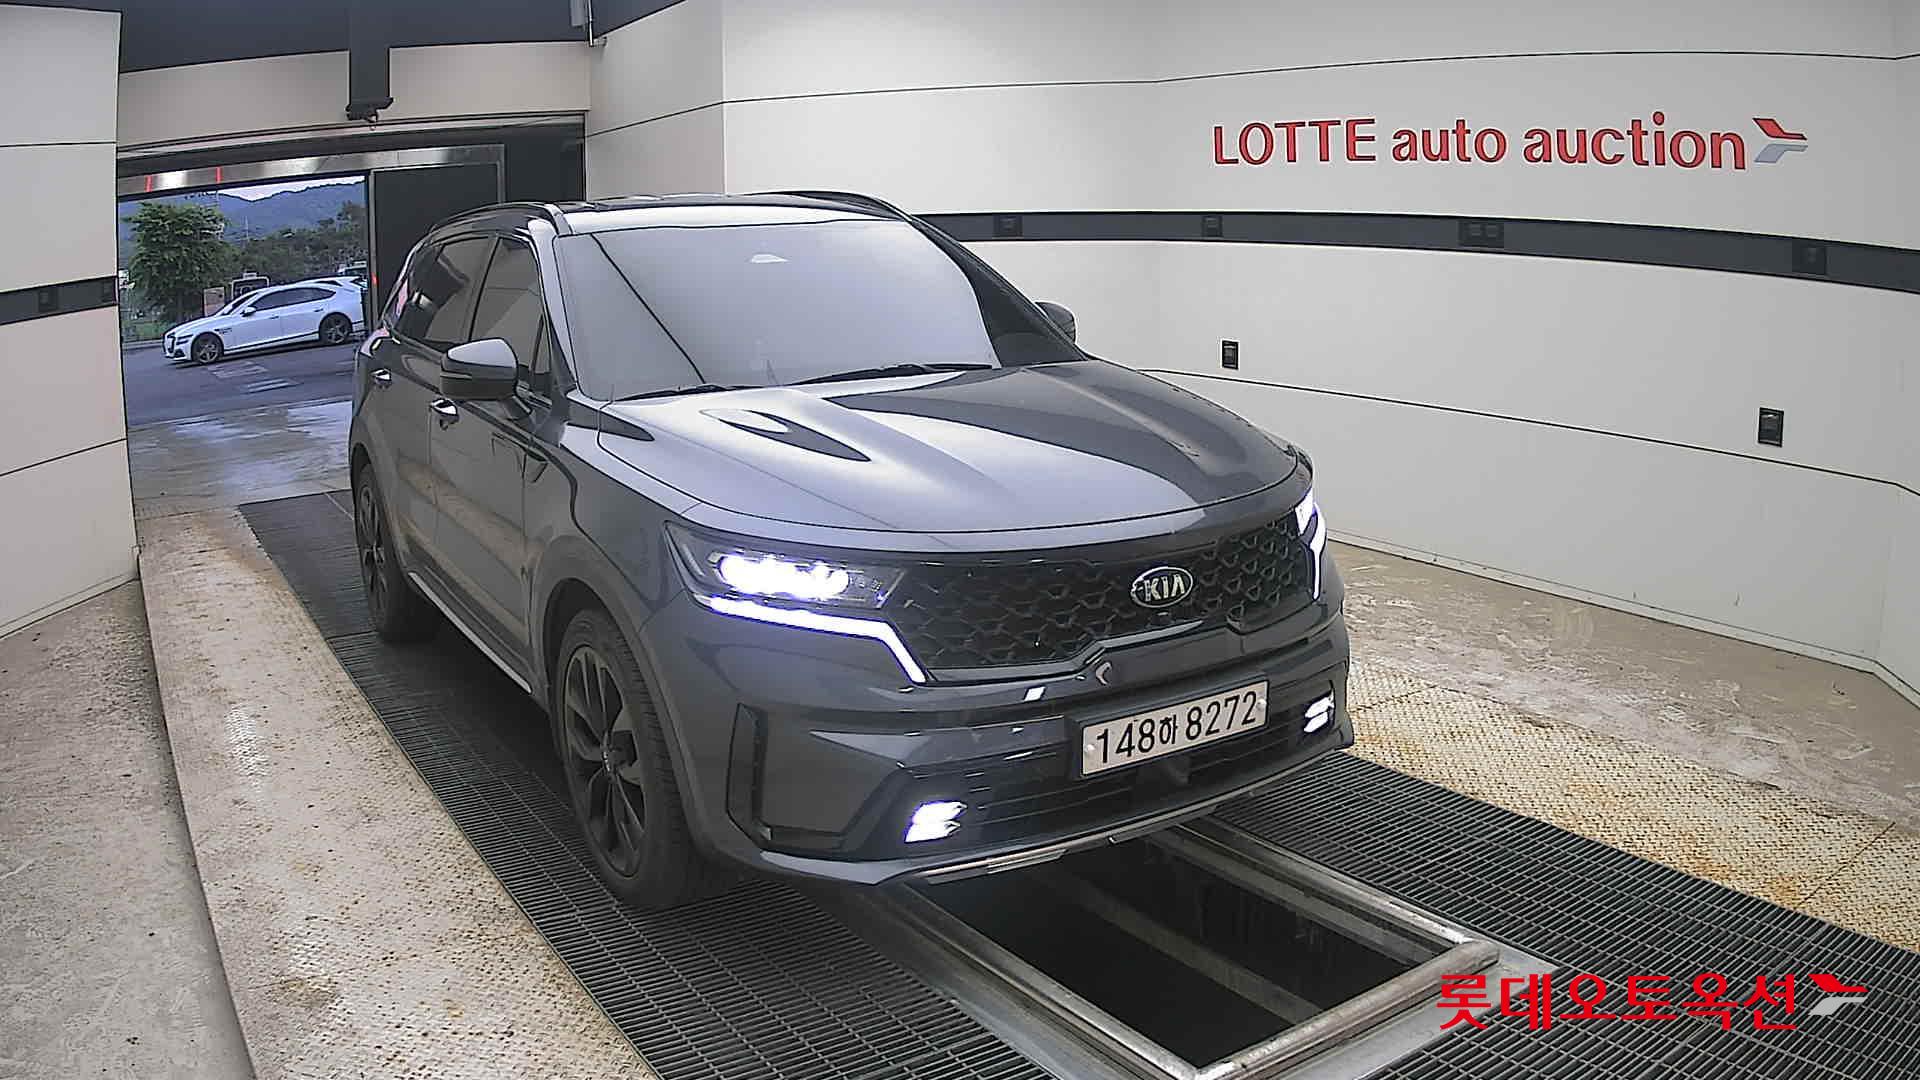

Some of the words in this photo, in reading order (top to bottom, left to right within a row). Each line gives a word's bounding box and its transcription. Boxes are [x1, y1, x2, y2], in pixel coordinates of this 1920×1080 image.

[1213, 118, 1377, 165] LOTTE
[1392, 118, 1507, 163] auto
[1523, 111, 1747, 170] auction
[1143, 573, 1186, 602] KIA
[1096, 714, 1178, 764] 148하
[1185, 691, 1257, 741] 8272
